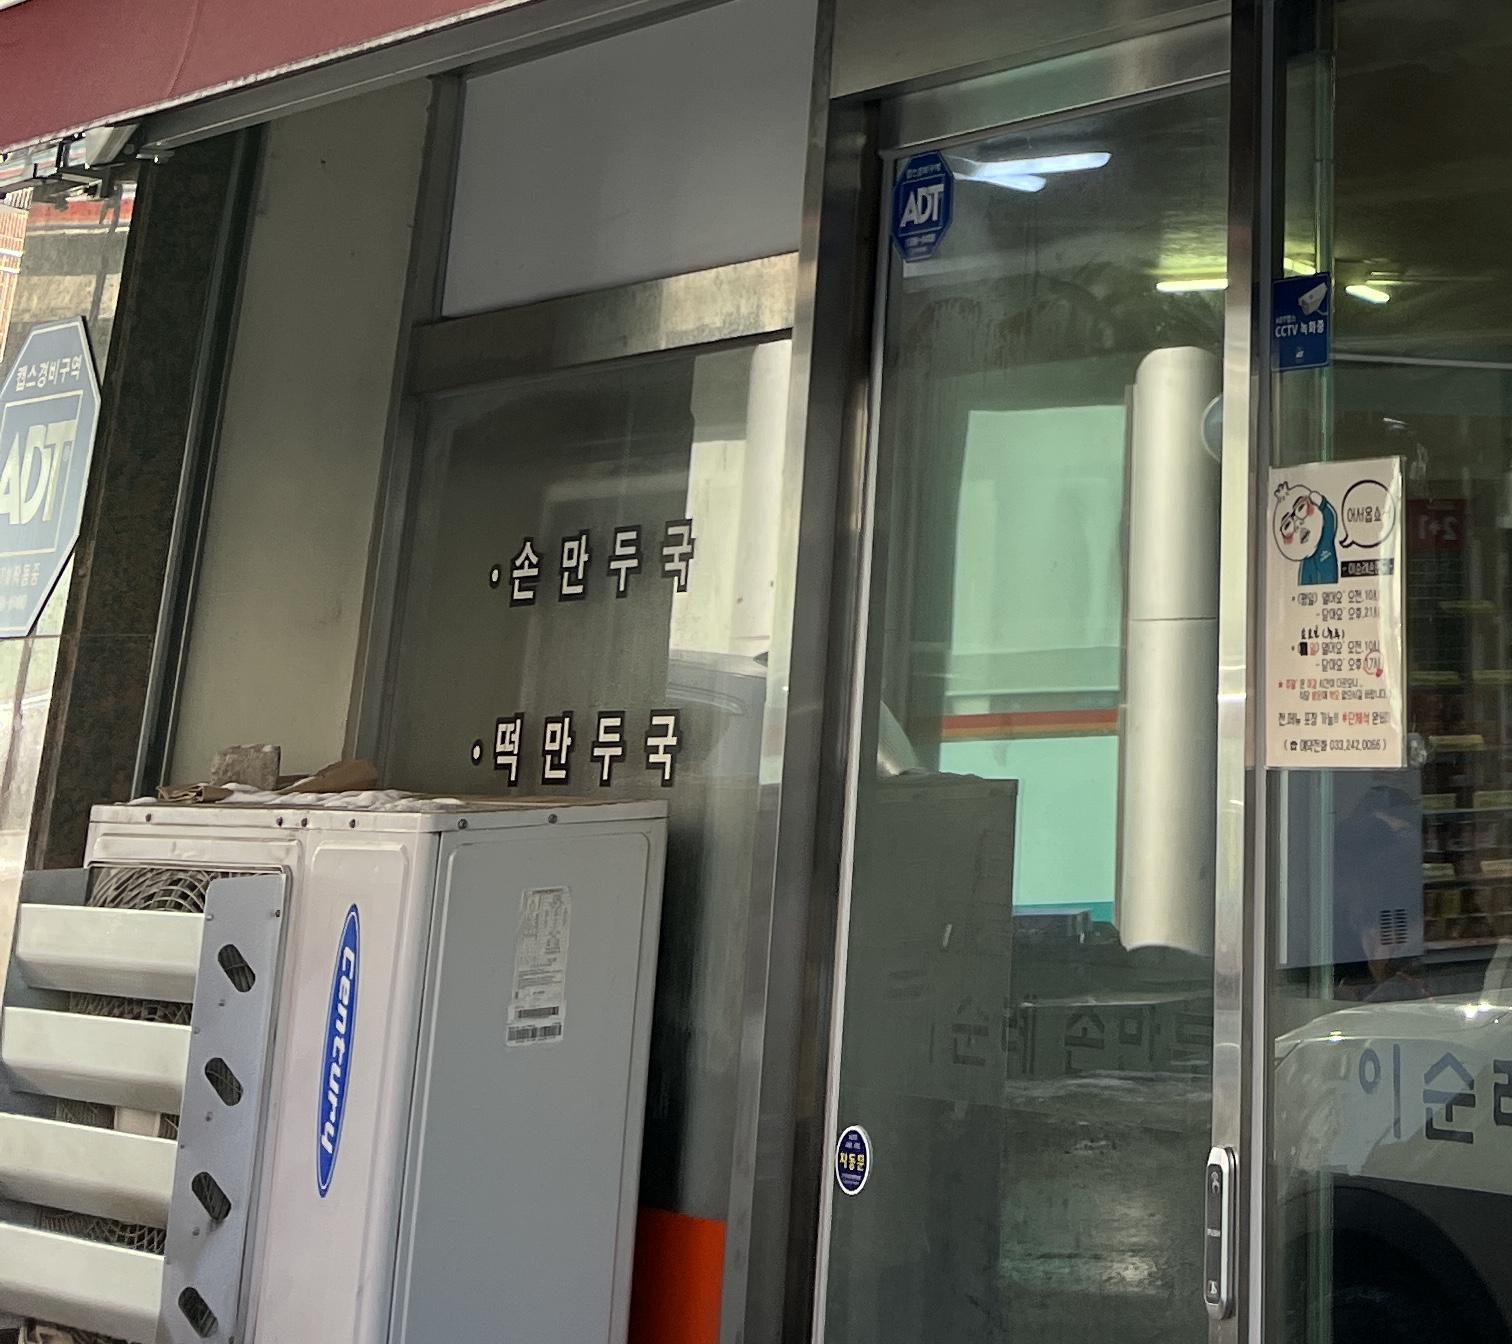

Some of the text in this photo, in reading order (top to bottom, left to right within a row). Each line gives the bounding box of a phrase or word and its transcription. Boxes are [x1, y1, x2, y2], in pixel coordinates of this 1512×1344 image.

[900, 184, 944, 227] ADT
[1275, 324, 1298, 338] CCTV
[16, 354, 82, 392] 캡스경비구역
[0, 418, 78, 525] ADT
[511, 522, 695, 603] 손만두국
[494, 714, 679, 783] 떡만두국
[839, 1151, 865, 1171] 자동문
